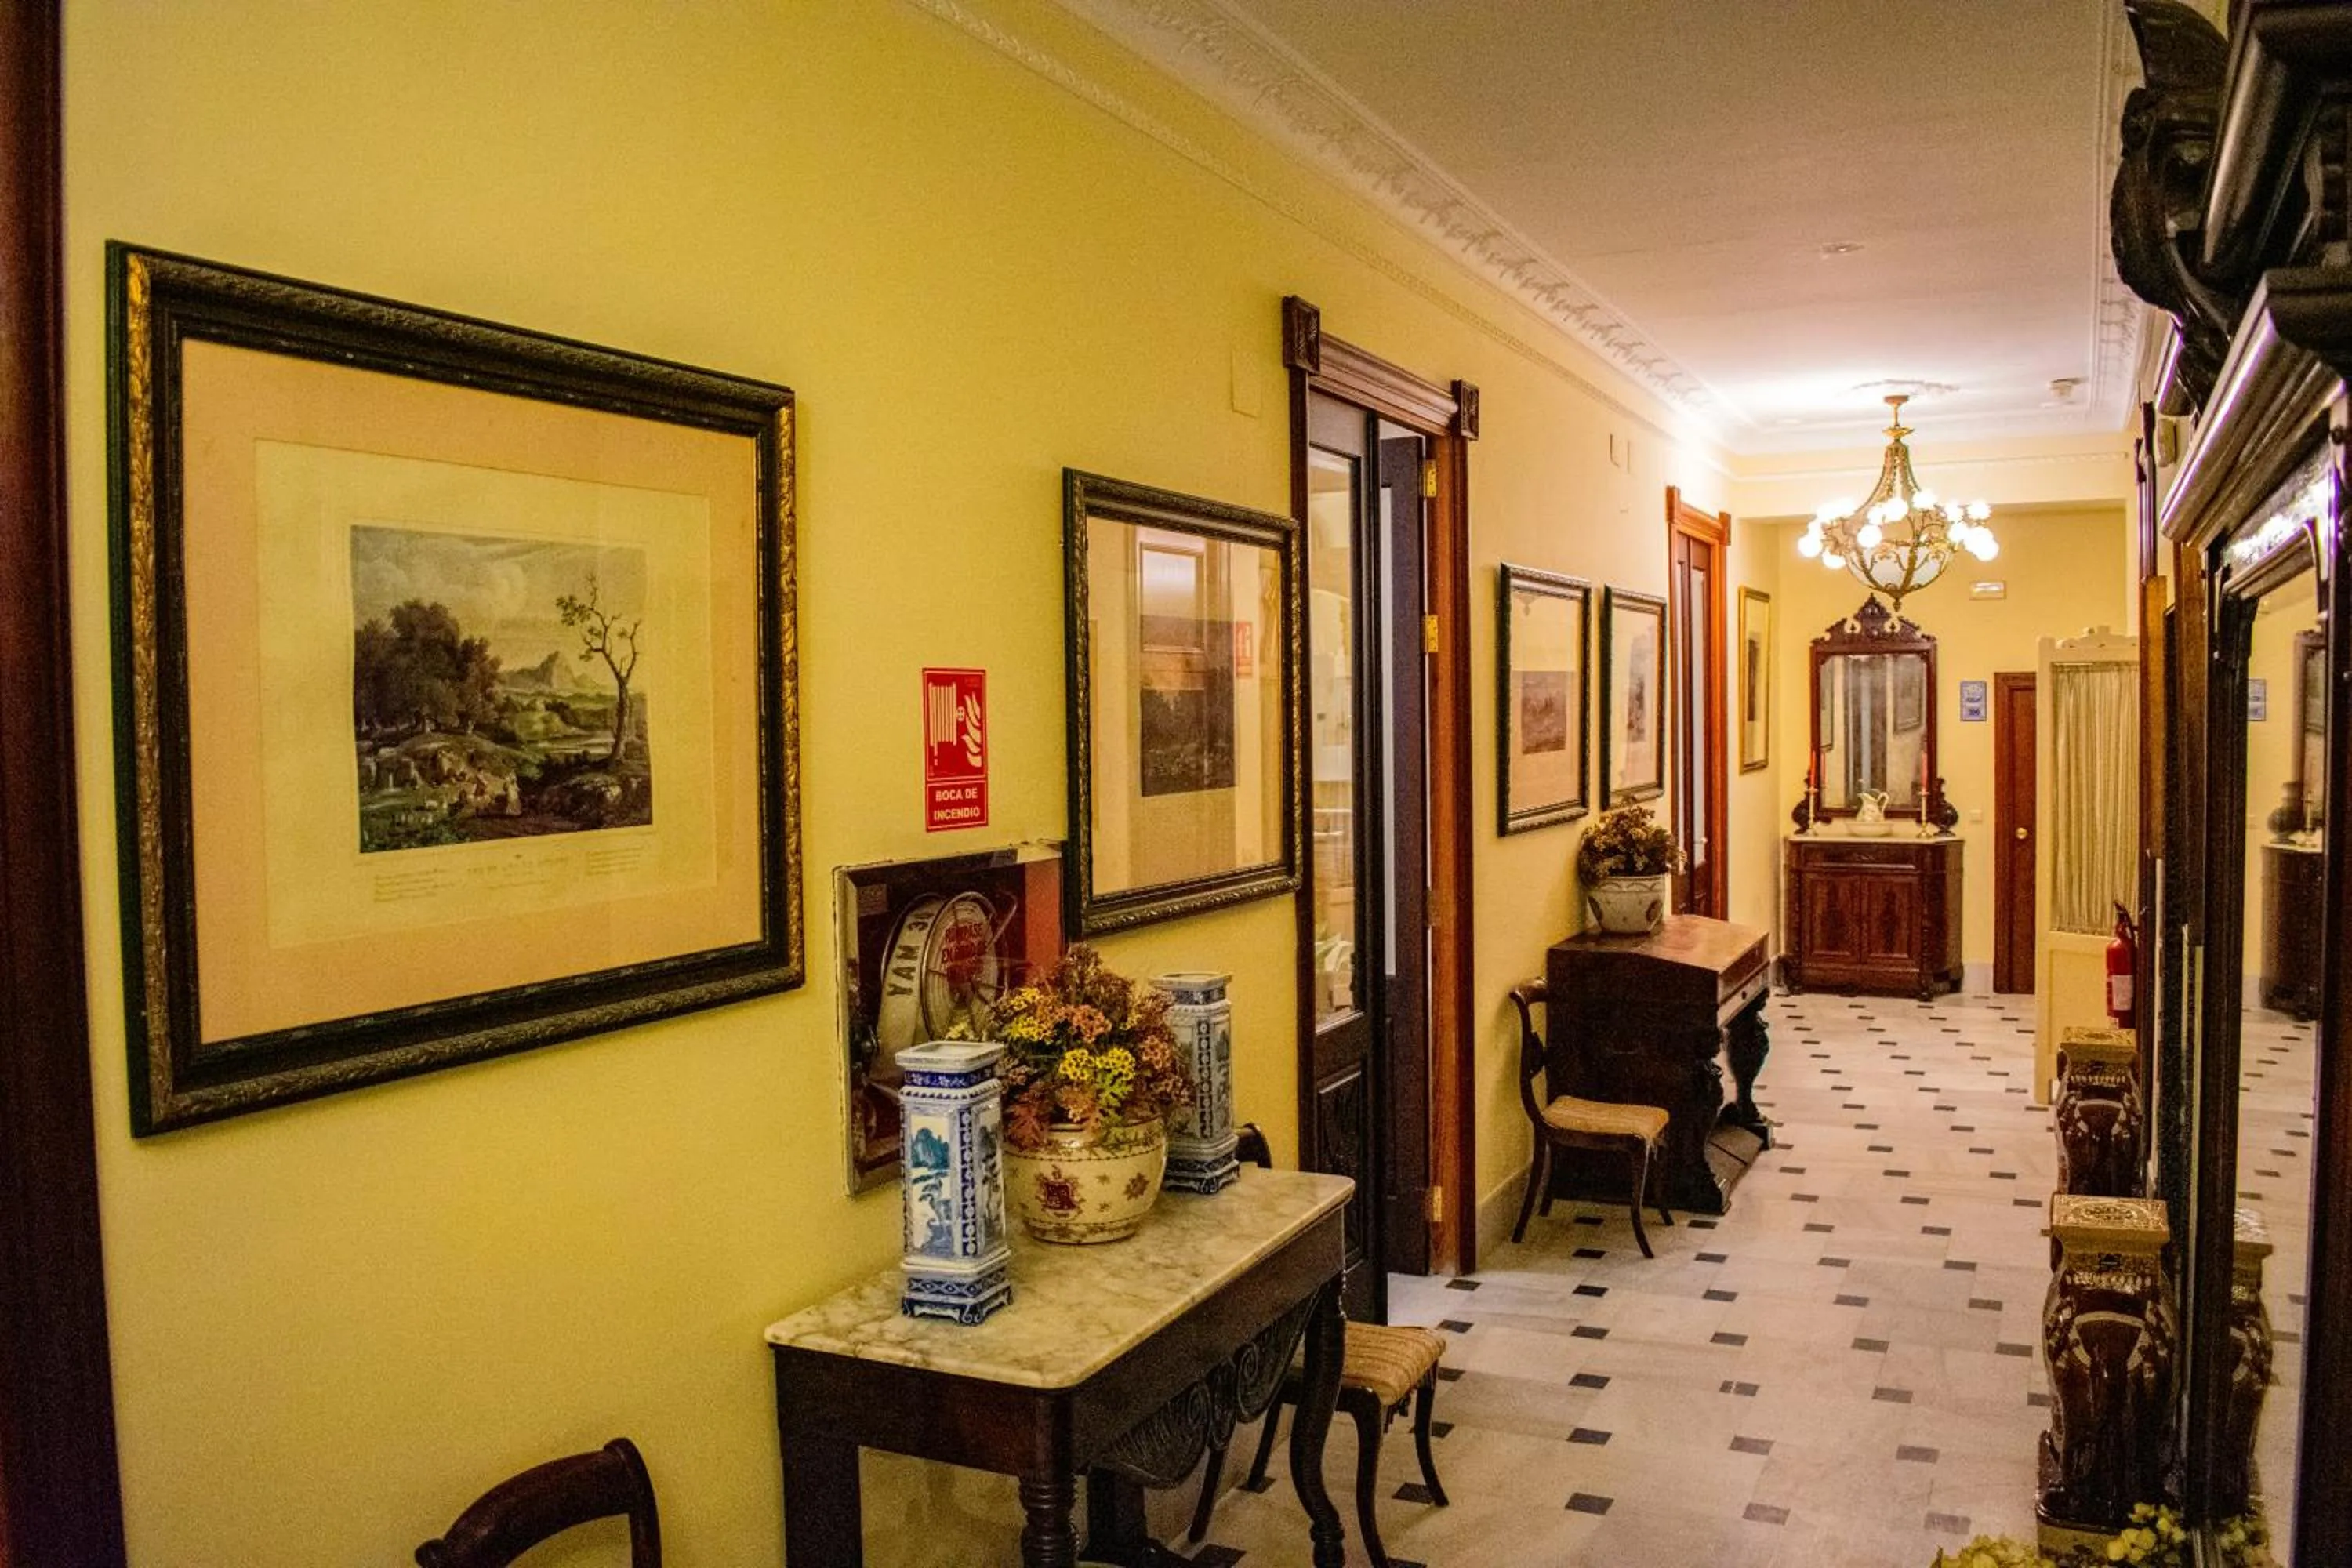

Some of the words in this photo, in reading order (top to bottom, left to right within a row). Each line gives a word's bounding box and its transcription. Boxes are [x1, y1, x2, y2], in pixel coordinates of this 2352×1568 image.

[935, 789, 963, 802] BOCA
[965, 787, 978, 799] DE
[934, 806, 980, 821] INCENDIO
[887, 945, 919, 996] YAM
